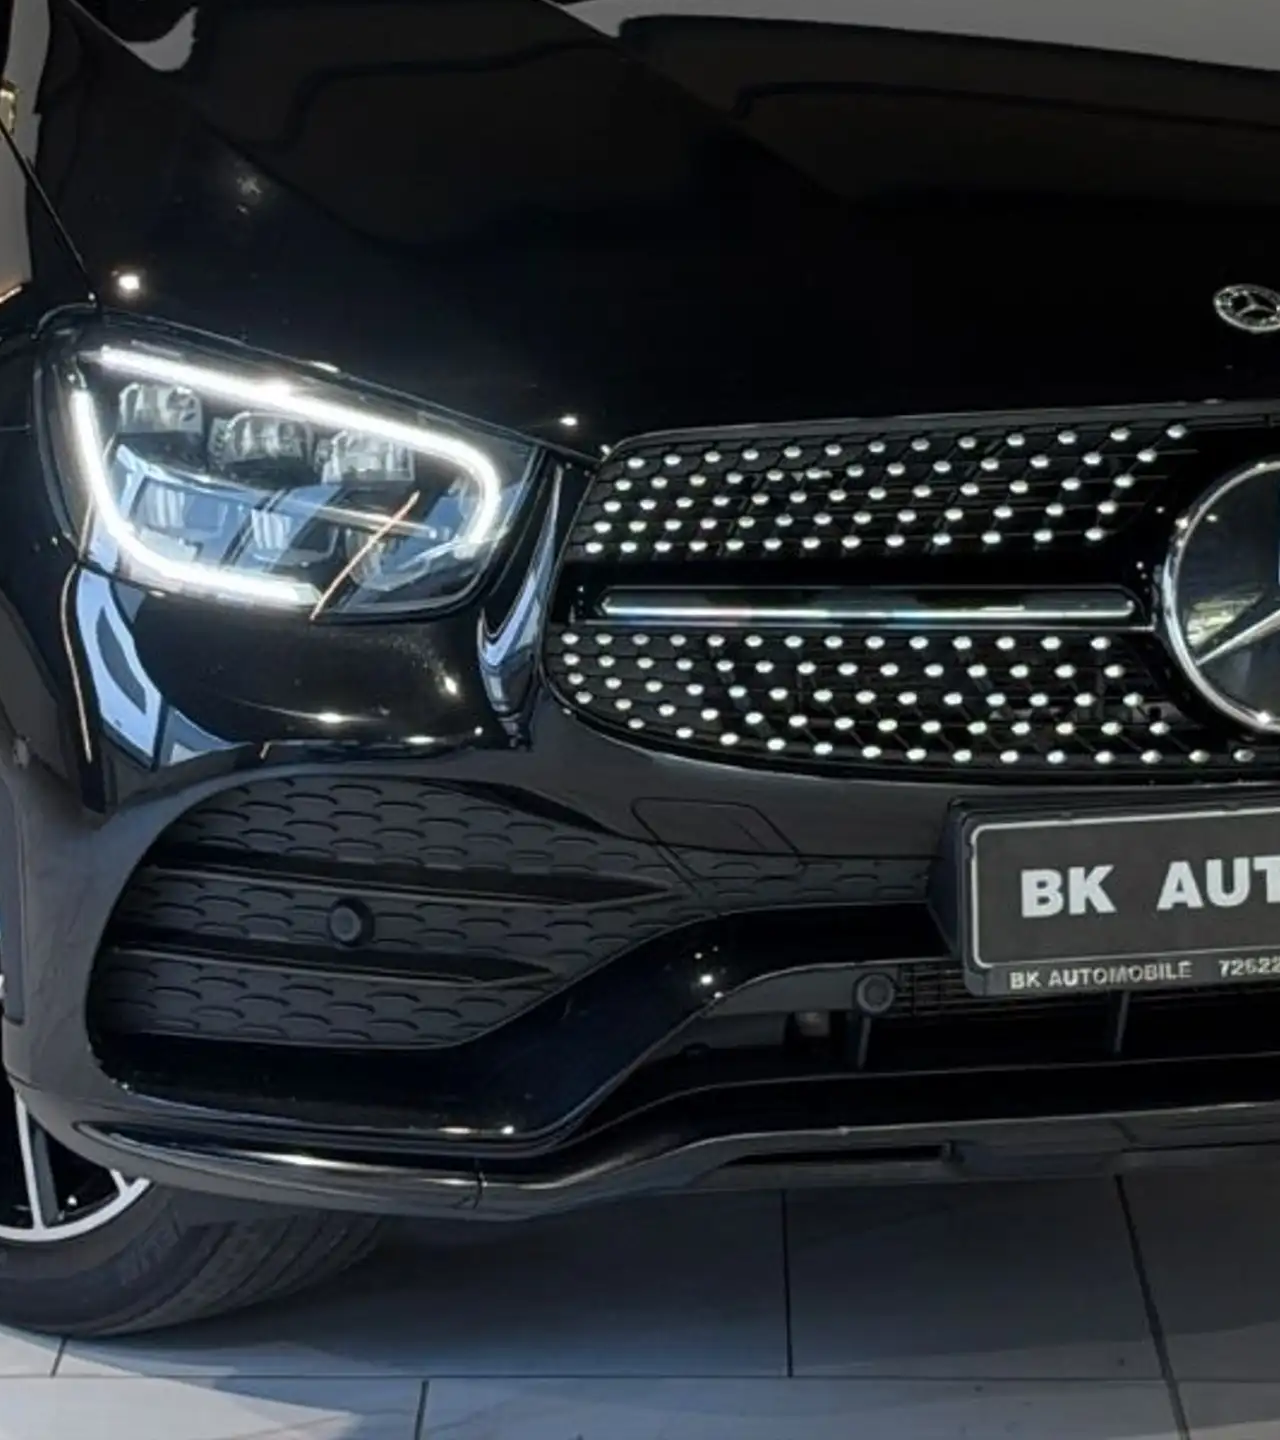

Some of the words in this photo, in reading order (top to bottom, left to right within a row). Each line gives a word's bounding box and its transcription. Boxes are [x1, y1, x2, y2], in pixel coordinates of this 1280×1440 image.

[1020, 865, 1116, 919] BK
[1009, 971, 1041, 990] BK
[1047, 960, 1193, 988] AUTOMOBILE
